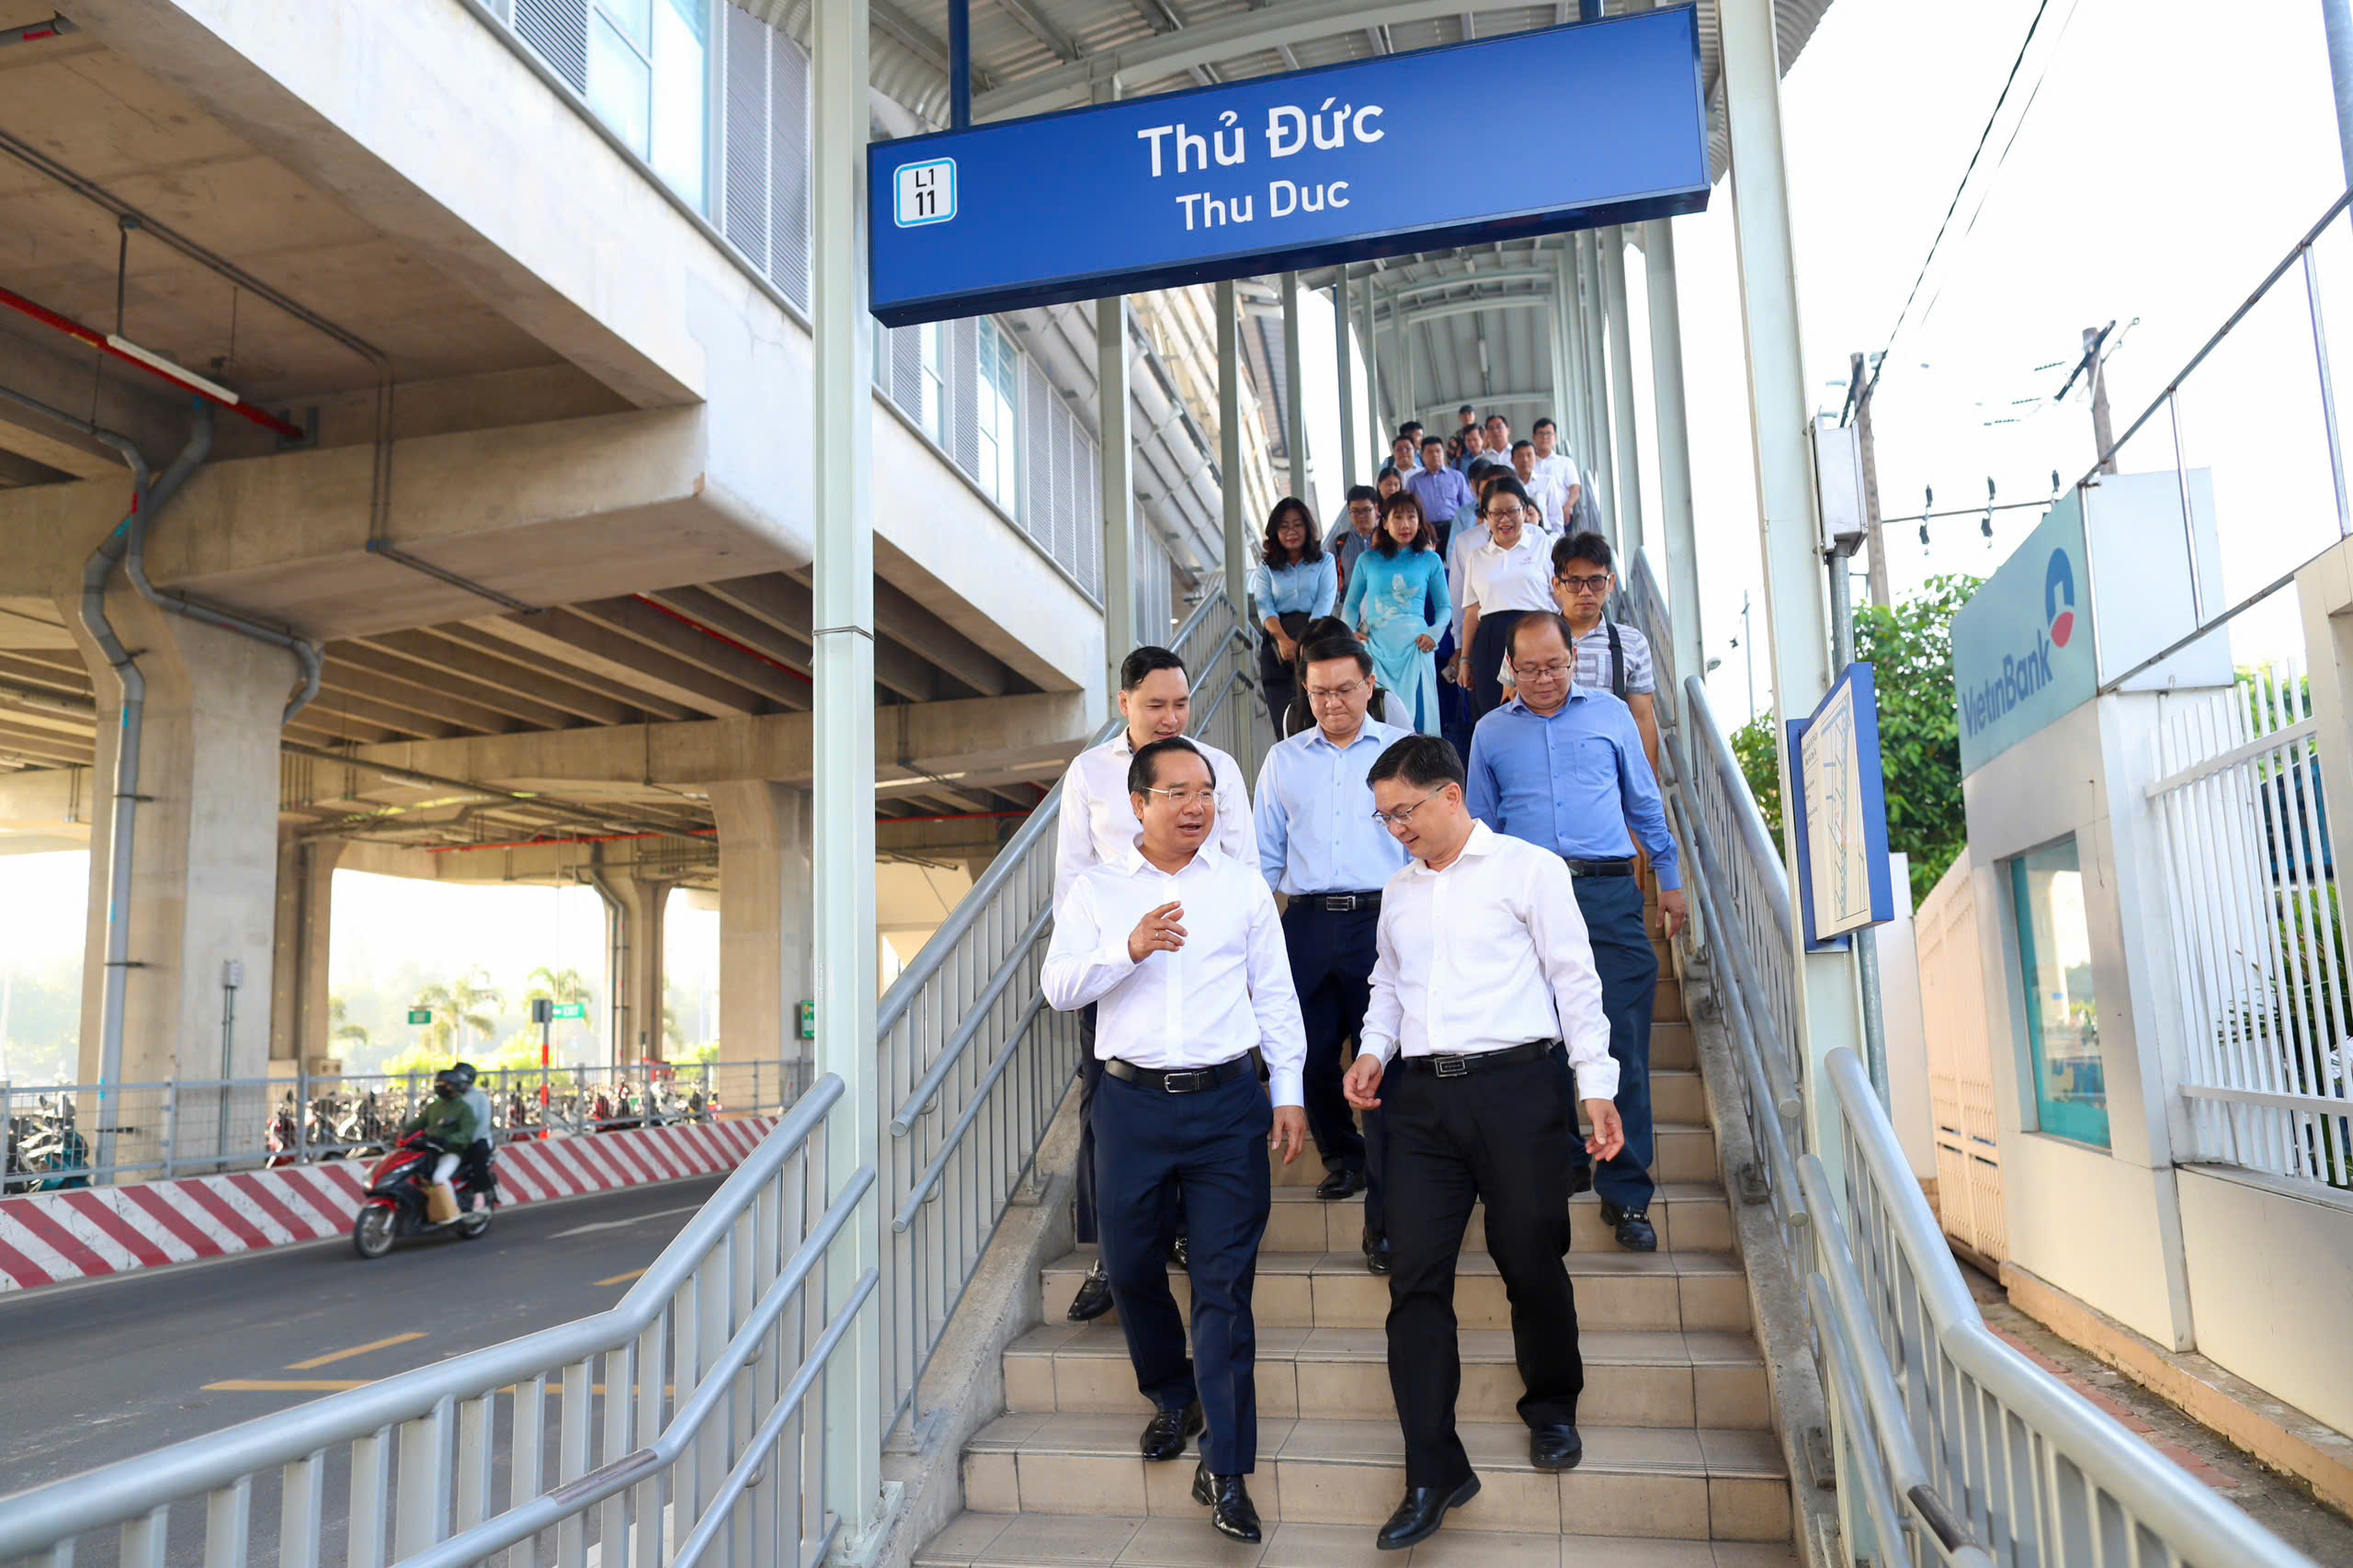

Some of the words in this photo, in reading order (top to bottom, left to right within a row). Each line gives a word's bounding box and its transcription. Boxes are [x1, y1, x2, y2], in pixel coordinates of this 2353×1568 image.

[1137, 110, 1245, 177] Thủ
[1266, 97, 1385, 158] Đức
[915, 168, 934, 187] L1
[915, 190, 935, 216] 11
[1176, 192, 1254, 231] Thu
[1269, 179, 1350, 218] Duc
[1962, 629, 2053, 739] VietinBank
